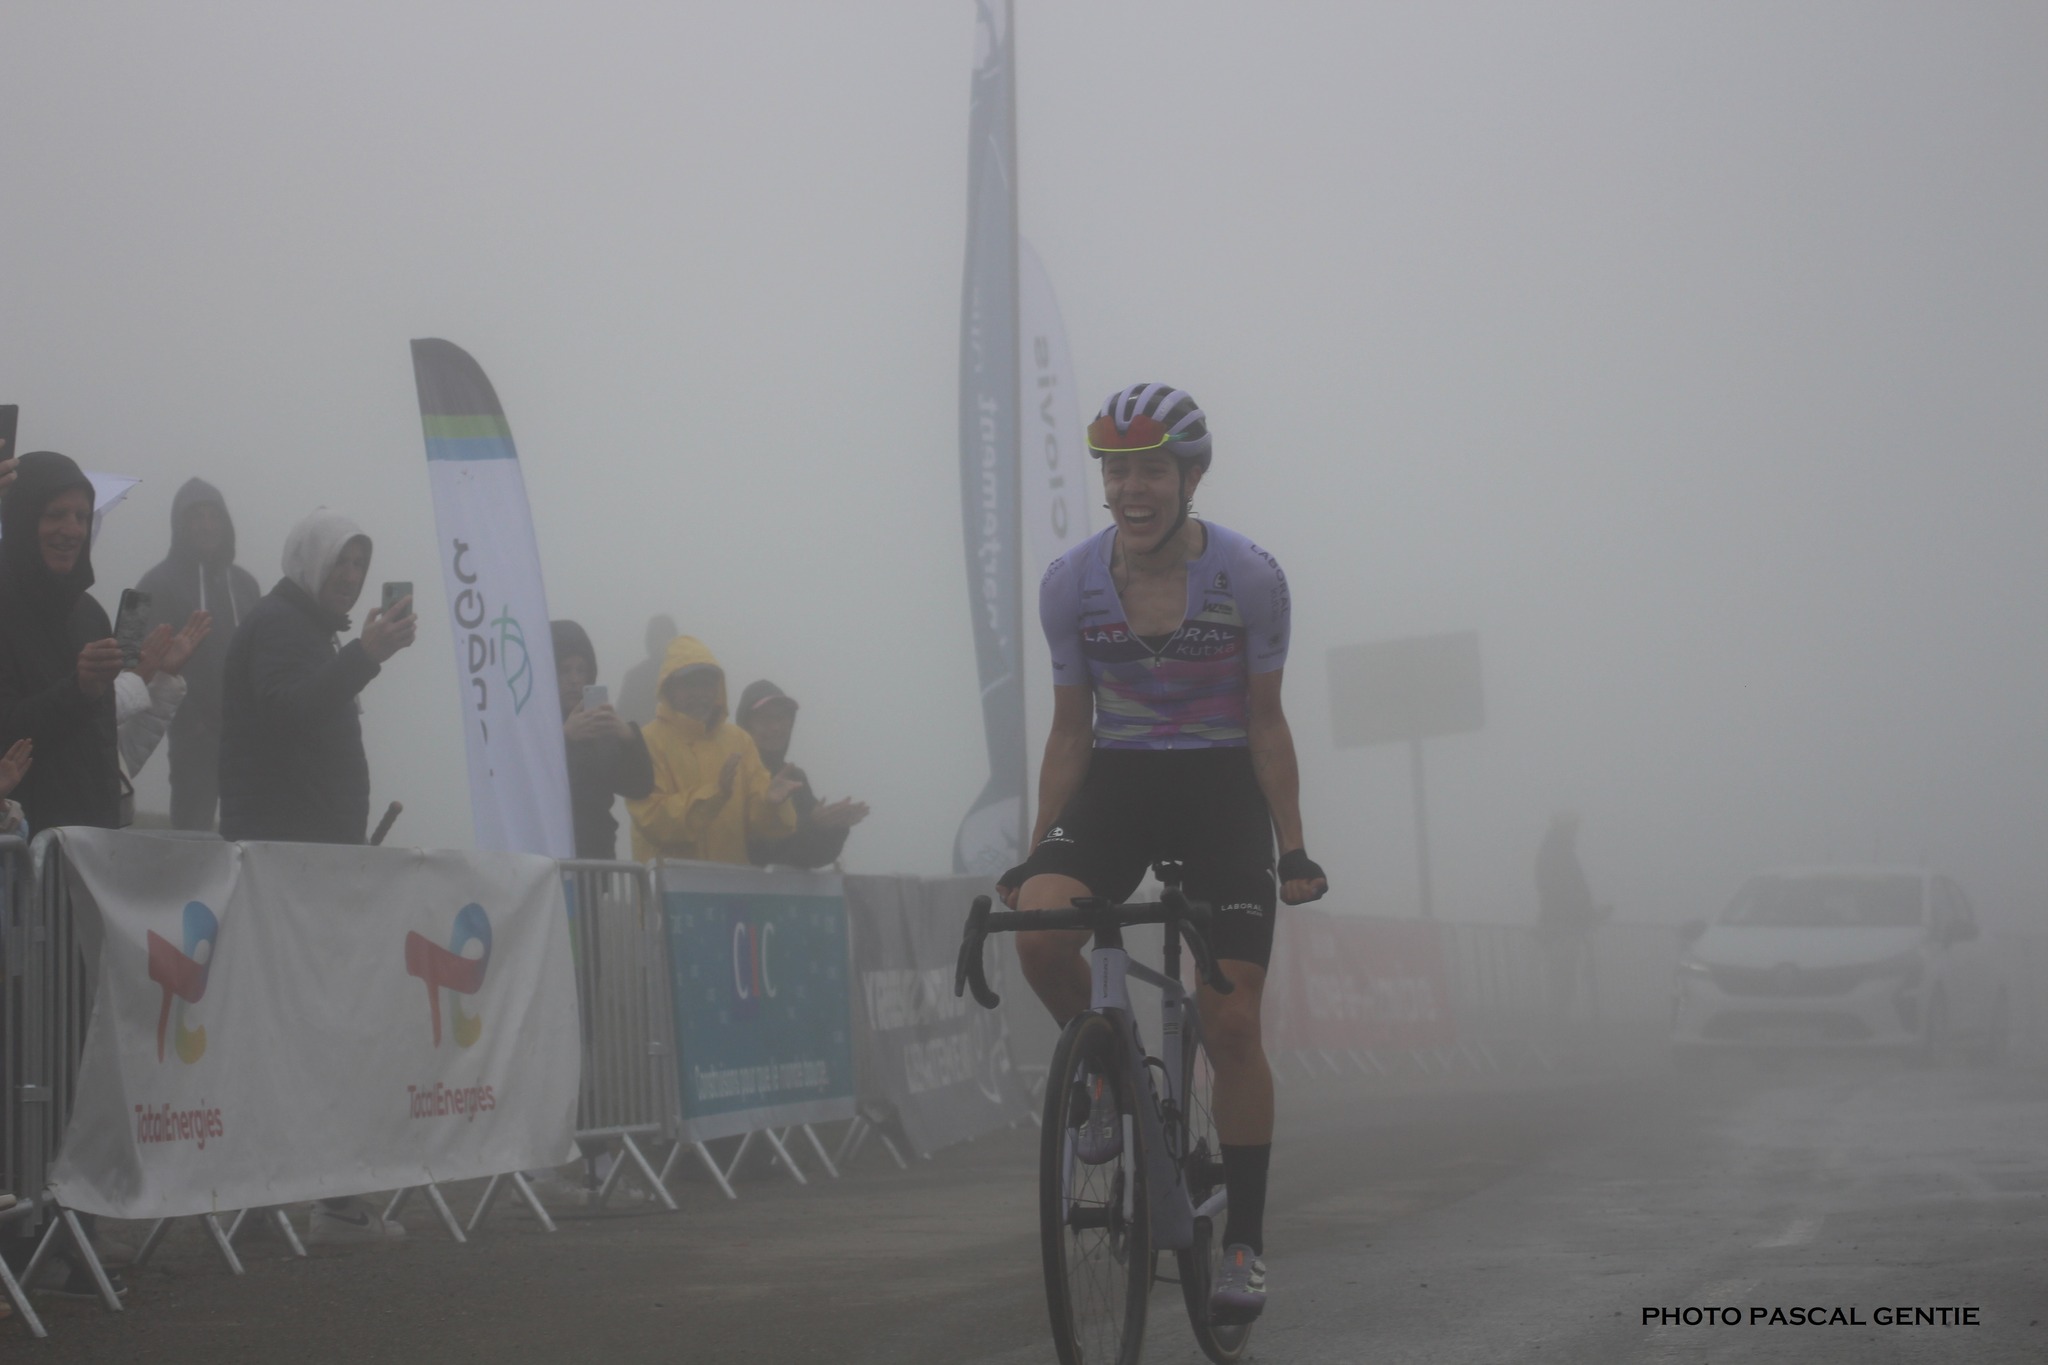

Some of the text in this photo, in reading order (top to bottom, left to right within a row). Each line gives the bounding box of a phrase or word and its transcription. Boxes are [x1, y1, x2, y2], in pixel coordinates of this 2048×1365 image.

[1221, 902, 1263, 912] LABORAL
[733, 921, 776, 1000] CIC
[134, 1098, 224, 1150] TotalEnergies
[407, 1077, 496, 1123] TotalEnergies
